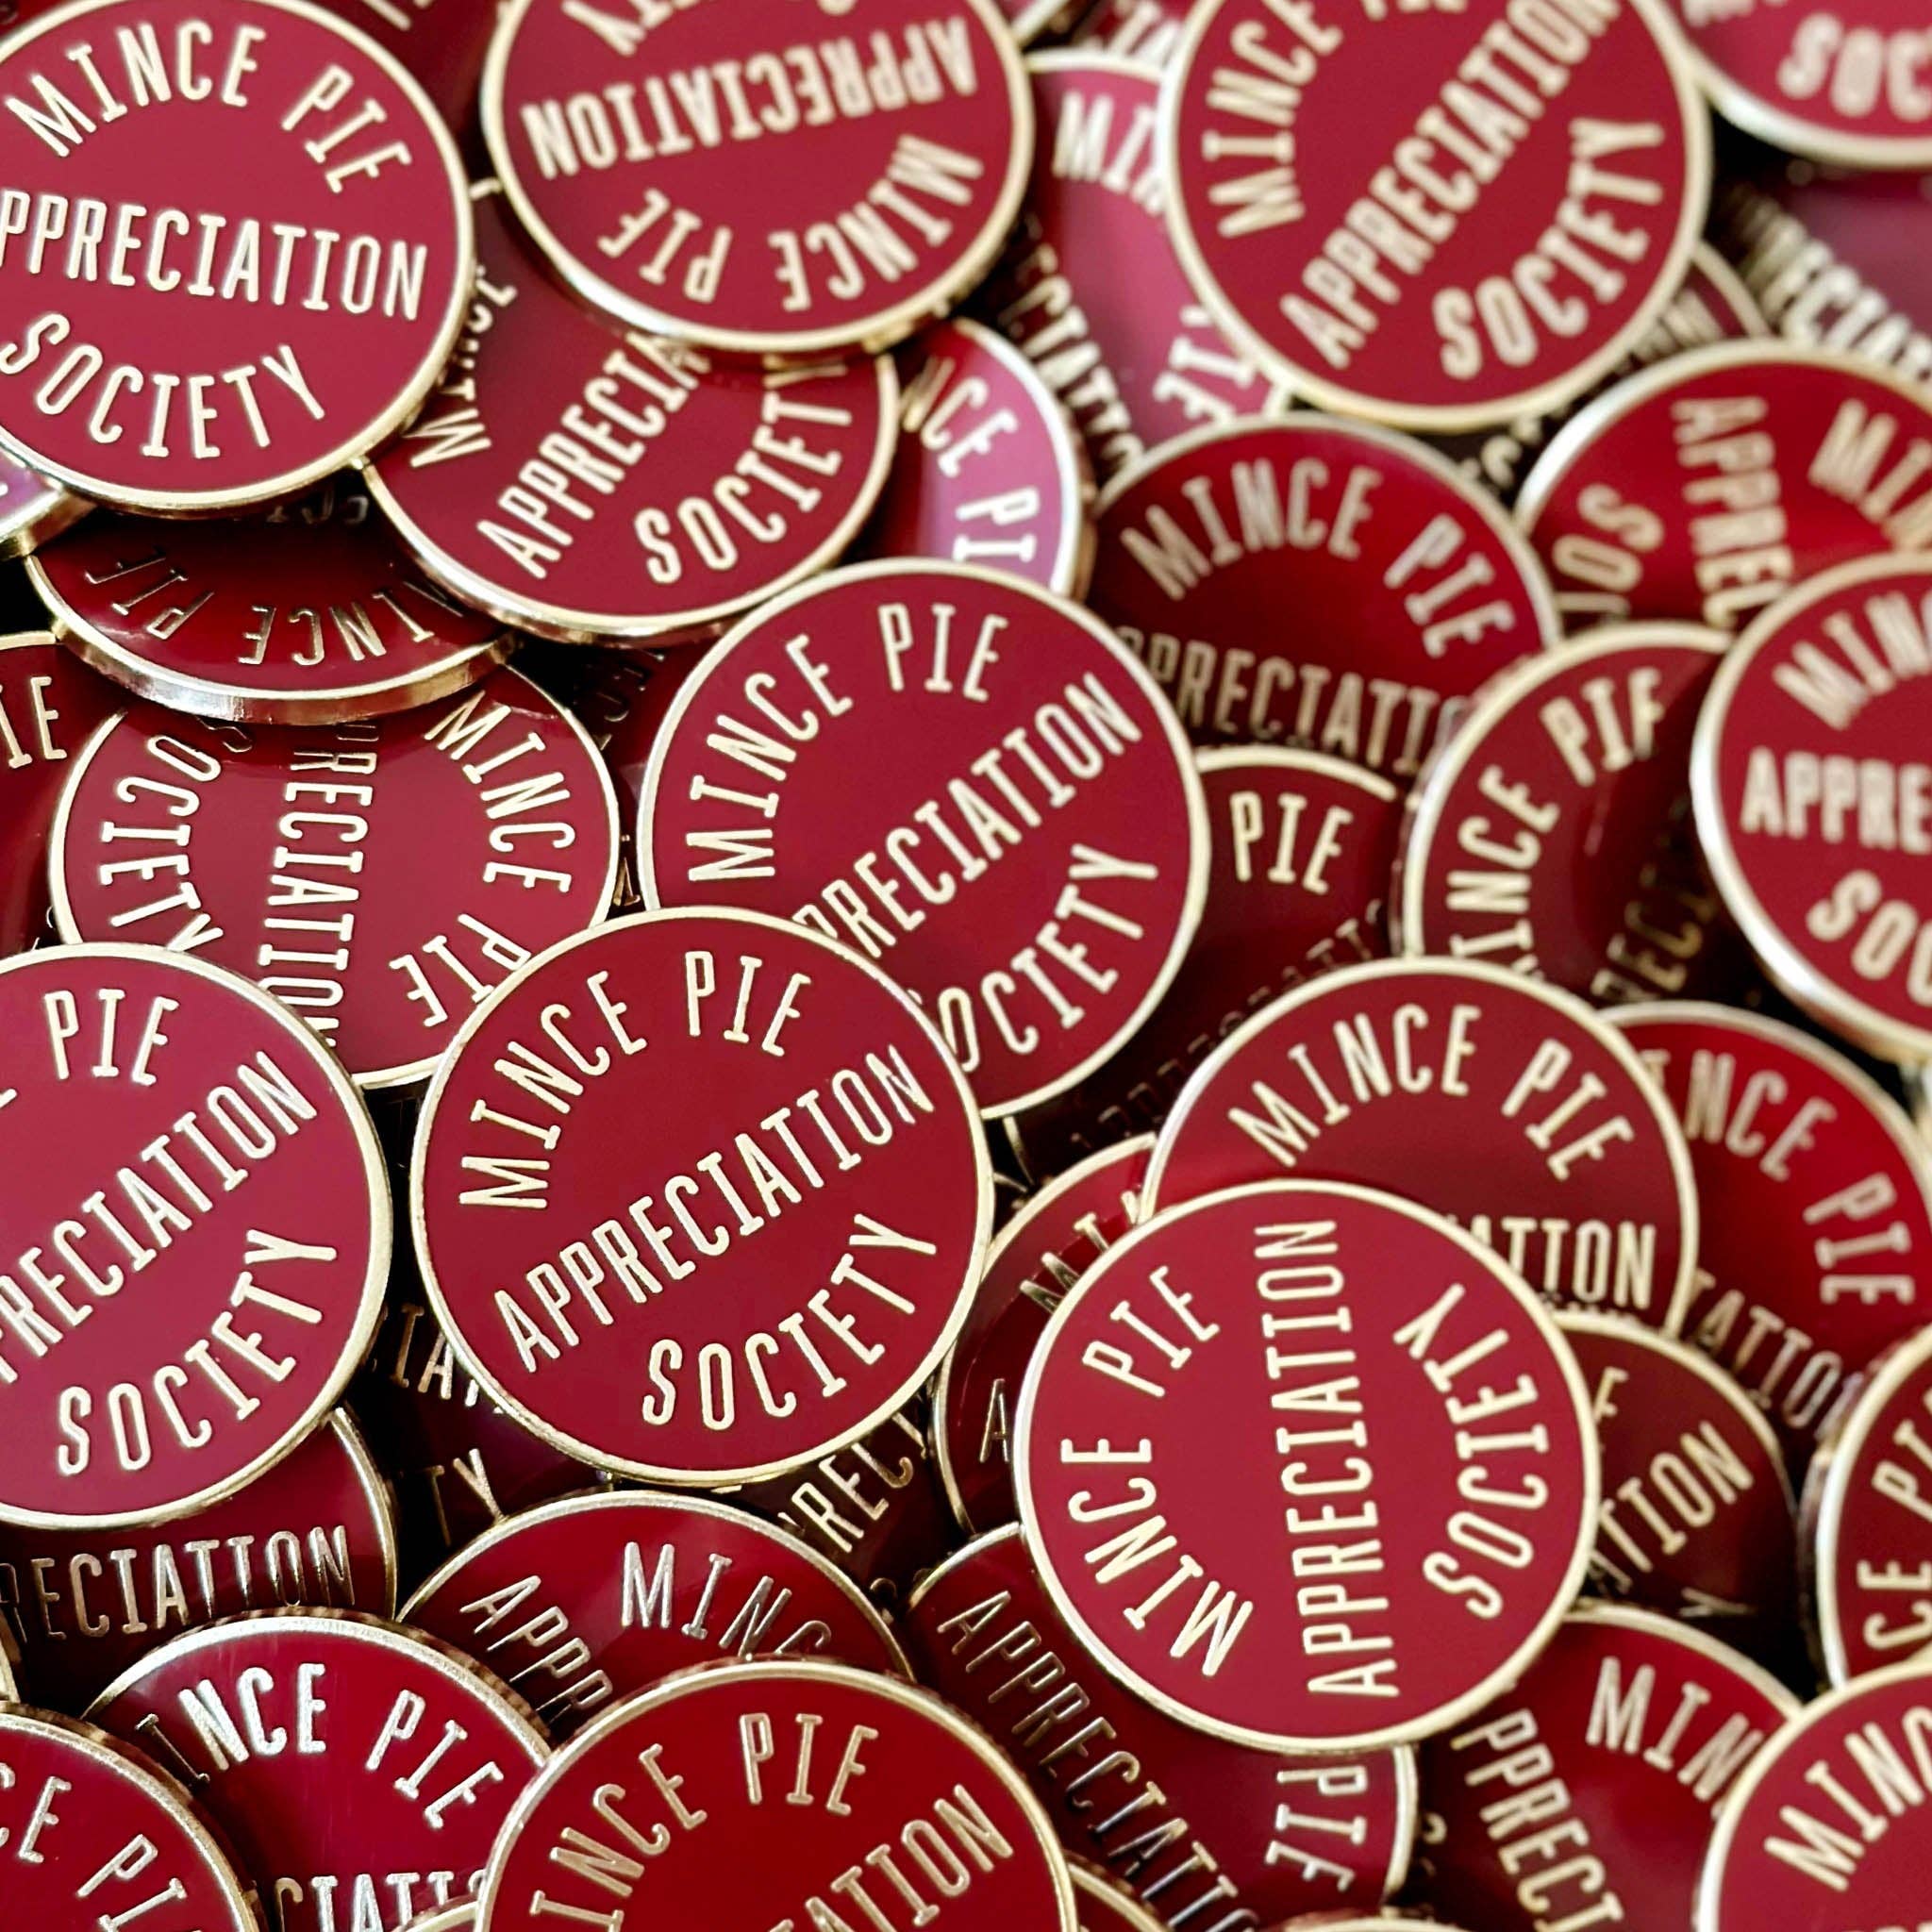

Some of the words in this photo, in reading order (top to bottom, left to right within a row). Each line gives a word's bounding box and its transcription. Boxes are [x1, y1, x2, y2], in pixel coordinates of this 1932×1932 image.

[3, 19, 267, 158] MINCE
[282, 64, 412, 193] PIE
[521, 16, 977, 179] APPRECIATION
[0, 190, 427, 321] PPRECIATION
[597, 189, 732, 303] PIE
[767, 134, 985, 311] MINCE
[1431, 117, 1664, 379] SOCIETY
[0, 312, 325, 459] SOCIETY
[476, 332, 711, 579] APPRECIA
[955, 487, 1041, 563] PI
[1121, 458, 1383, 600] MINCE
[1383, 512, 1515, 658] PIE
[0, 676, 68, 769] IE
[424, 688, 575, 892] MINCE
[686, 635, 853, 881] MINCE
[877, 603, 1009, 702] PIE
[791, 672, 1142, 958] PRECIATION
[1230, 791, 1353, 894] PIE
[1446, 764, 1561, 980] INCE
[43, 988, 179, 1087] PIE
[389, 911, 532, 1028] PIE
[908, 843, 1158, 1073] OCIETY
[459, 970, 648, 1208] MINCE
[685, 950, 811, 1058] PIE
[1228, 1003, 1481, 1167] MINCE
[1501, 1039, 1635, 1180] PIE
[0, 1050, 318, 1384] RECIATION
[493, 1044, 934, 1373] APPRECIATION
[1803, 1172, 1916, 1305] PIE
[57, 1229, 338, 1476] SOCIETY
[641, 1213, 937, 1431] SOCIETY
[1081, 1265, 1220, 1398] PIE
[1255, 1220, 1400, 1697] APPRECIATION
[1391, 1283, 1548, 1619] SOCIETY
[1060, 1439, 1254, 1677] MINCE
[135, 1663, 327, 1784] INCE
[366, 1689, 505, 1828] PIE
[528, 1744, 708, 1932] INCE
[739, 1712, 878, 1816] PIE
[1264, 1765, 1368, 1891] PIE
